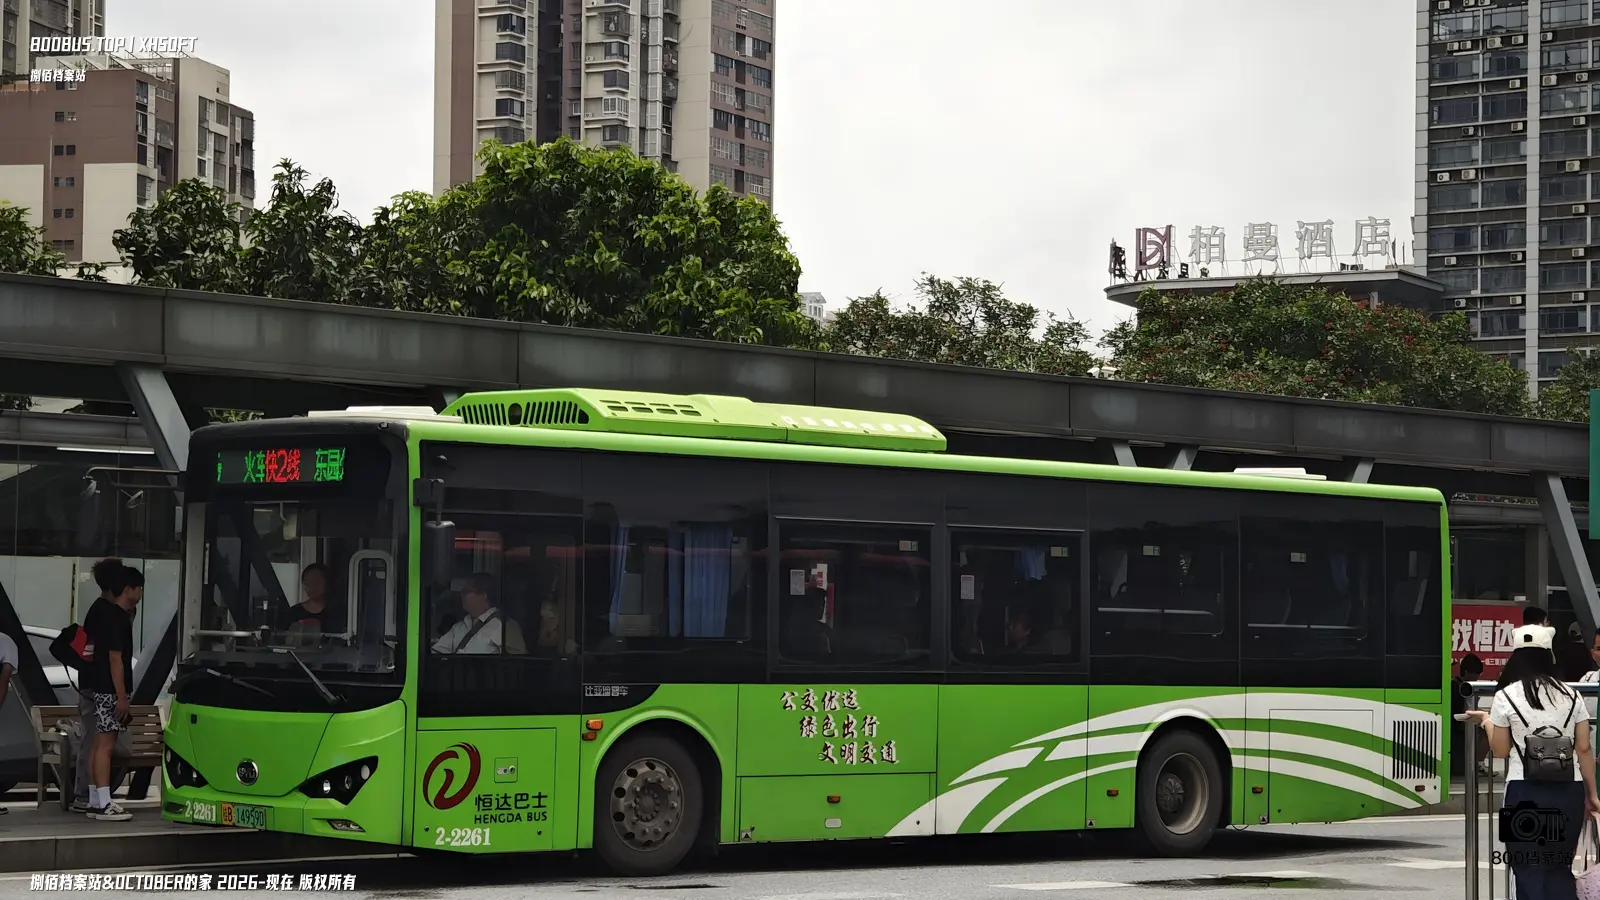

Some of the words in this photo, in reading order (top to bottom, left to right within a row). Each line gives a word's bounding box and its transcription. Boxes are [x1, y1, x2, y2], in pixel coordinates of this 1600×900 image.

[1188, 216, 1391, 265] 柏曼酒店
[1452, 618, 1515, 652] 找恒达
[799, 713, 880, 739] 绿色出行
[818, 740, 899, 765] 文明交通
[185, 800, 217, 821] 2-2261
[474, 792, 548, 811] 恒达巴士
[474, 813, 522, 825] HENGDA
[527, 811, 548, 822] BUS
[435, 827, 491, 847] 2-2261
